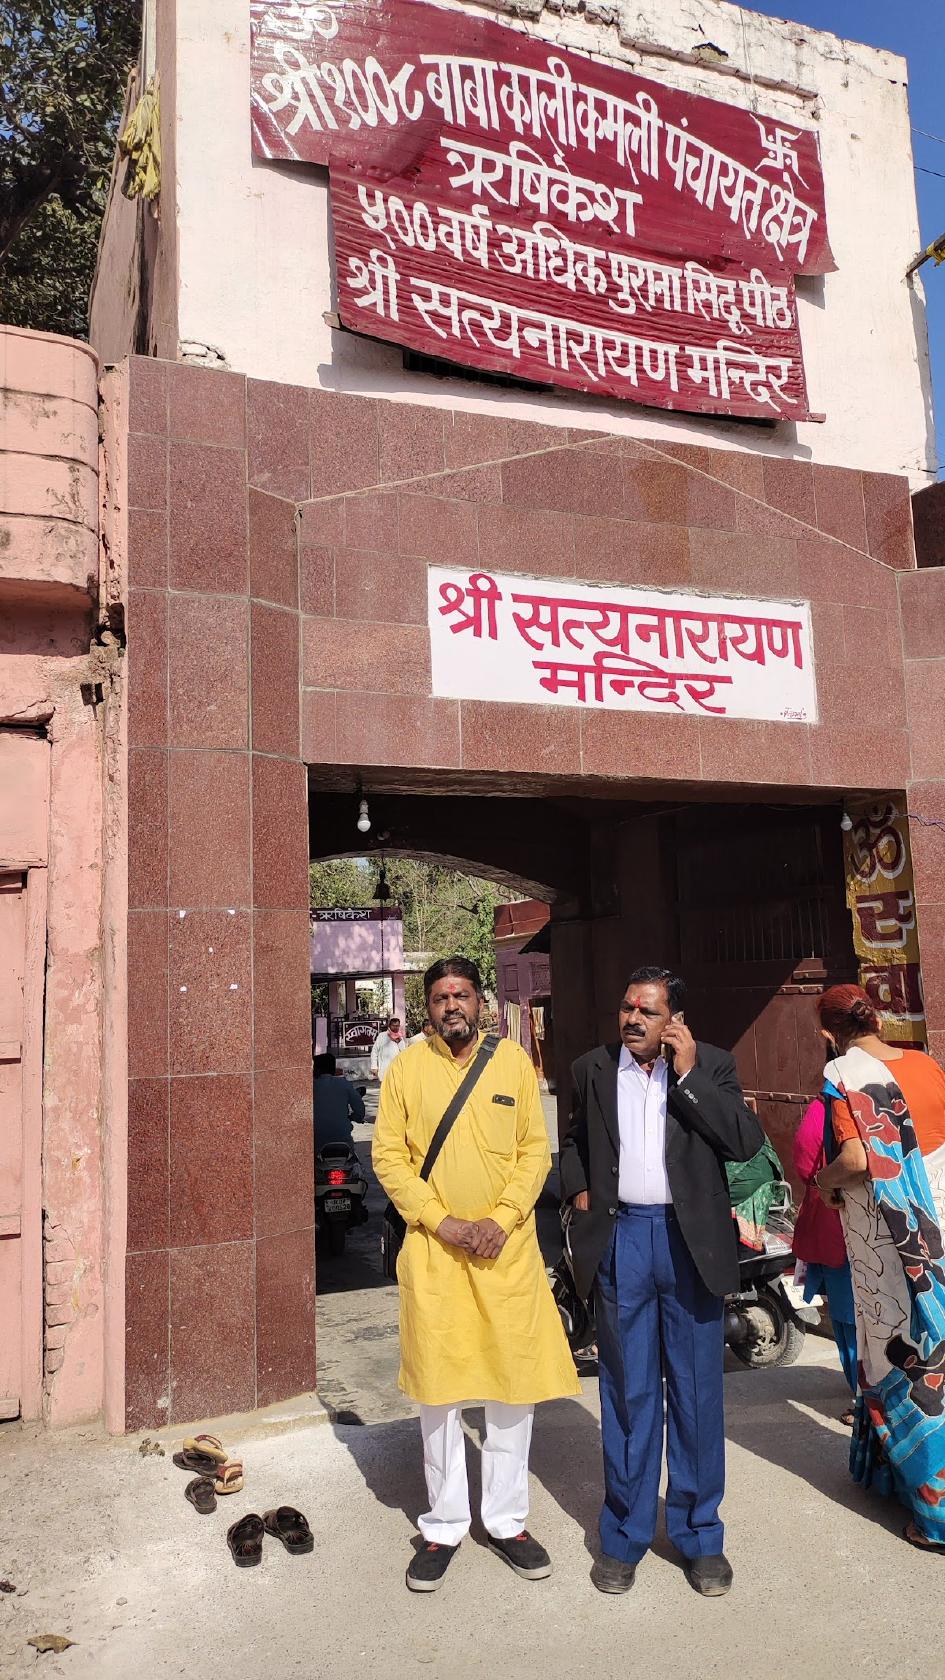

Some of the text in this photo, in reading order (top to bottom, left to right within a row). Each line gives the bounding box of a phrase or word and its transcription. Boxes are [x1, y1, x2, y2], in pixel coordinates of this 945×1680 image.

[261, 40, 819, 265] श्री १००८ बाबा काली कमली पंचायत क्षेत्र
[436, 203, 493, 270] वर्ष
[493, 221, 608, 297] अधिक
[738, 267, 793, 330] पीठ
[346, 248, 799, 413] श्री सत्यनारायण मन्दिर
[437, 572, 803, 670] श्री सत्यनारायण
[531, 650, 734, 715] मन्दिर
